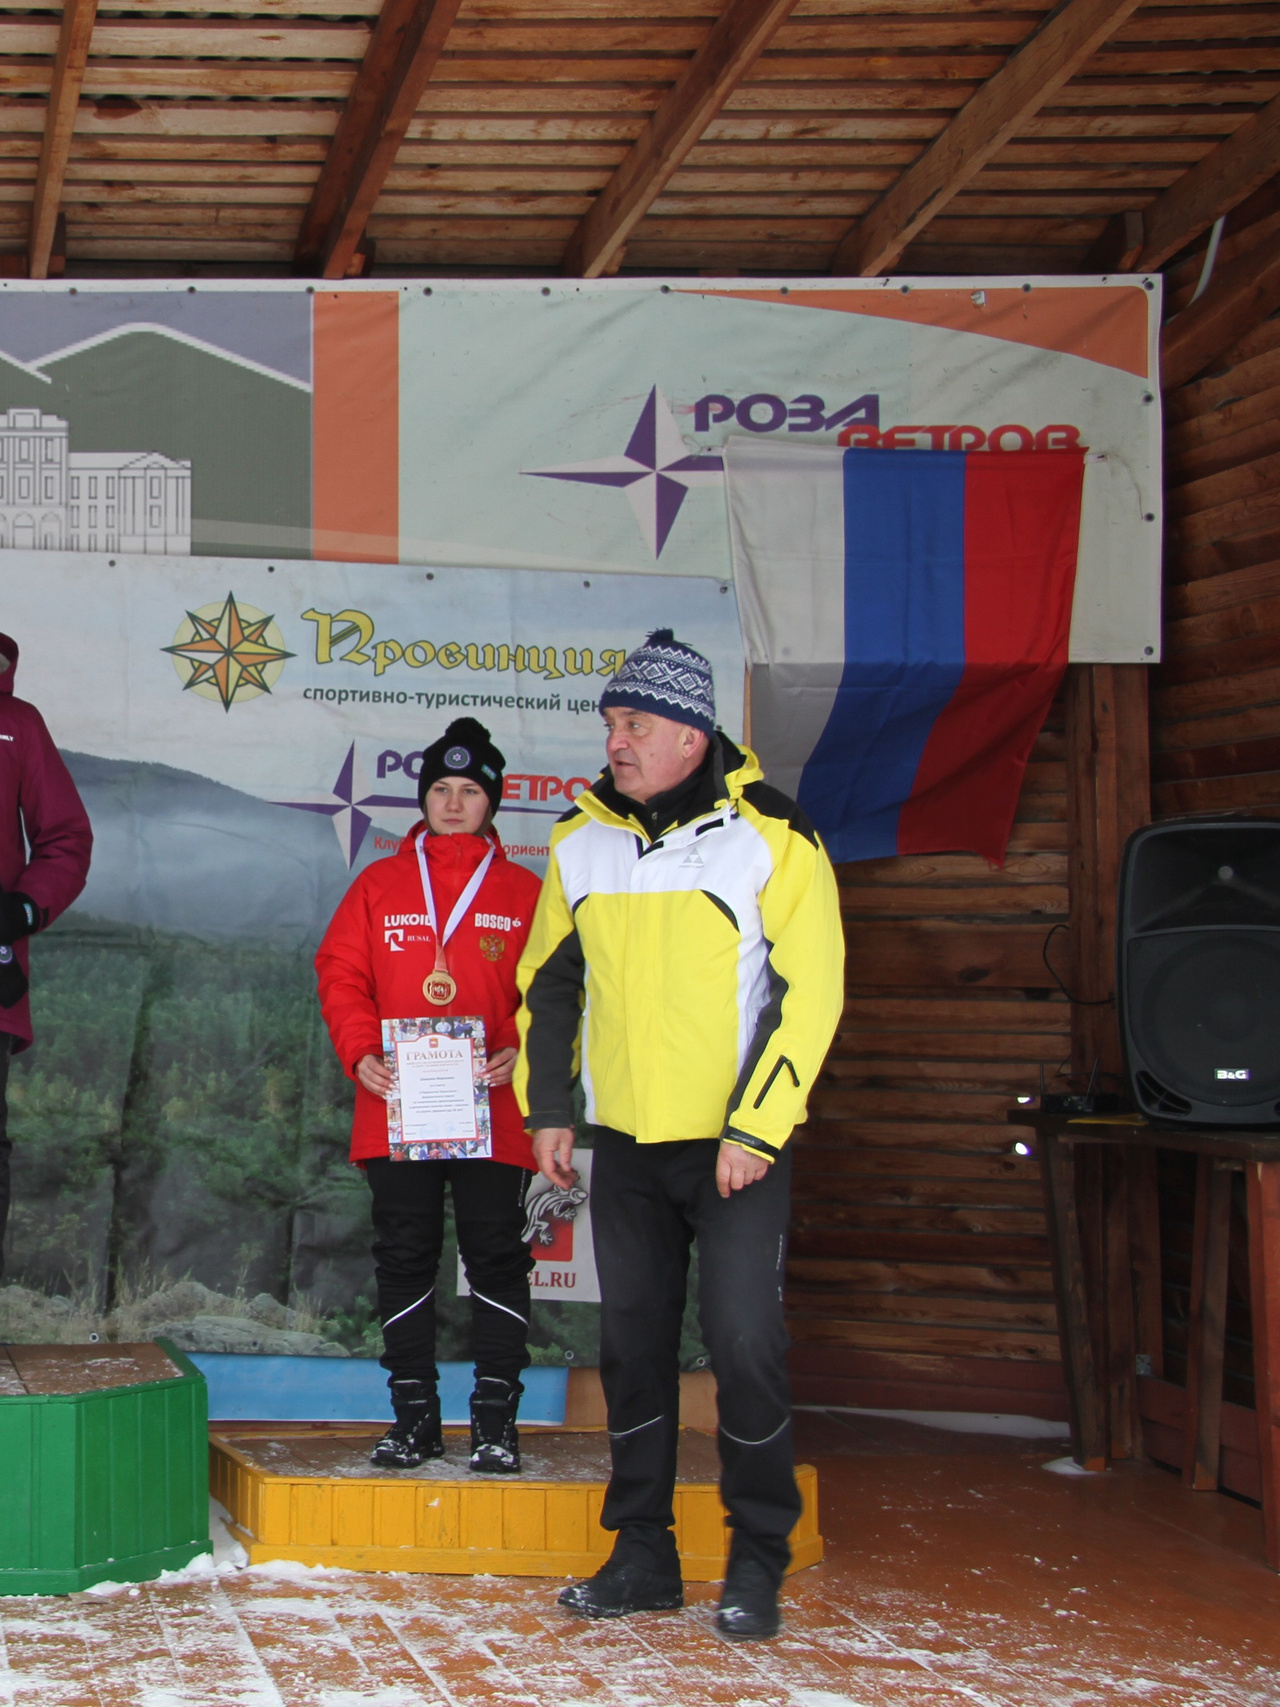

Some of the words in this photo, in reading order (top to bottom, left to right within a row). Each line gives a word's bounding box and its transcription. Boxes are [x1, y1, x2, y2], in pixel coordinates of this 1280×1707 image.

[694, 393, 880, 433] РОЗА
[300, 607, 626, 680] Провинция
[302, 687, 561, 711] спортивно-туристический
[567, 699, 600, 715] цен
[376, 749, 424, 780] РО
[501, 773, 593, 802] ЕТРО
[374, 835, 403, 854] Клу
[503, 844, 550, 858] ориент
[384, 913, 432, 928] LUKOIL
[474, 912, 511, 932] BOSCO
[407, 935, 431, 943] RUSAL
[406, 1050, 464, 1061] ГРАМОТА
[1217, 1070, 1247, 1080] B&G
